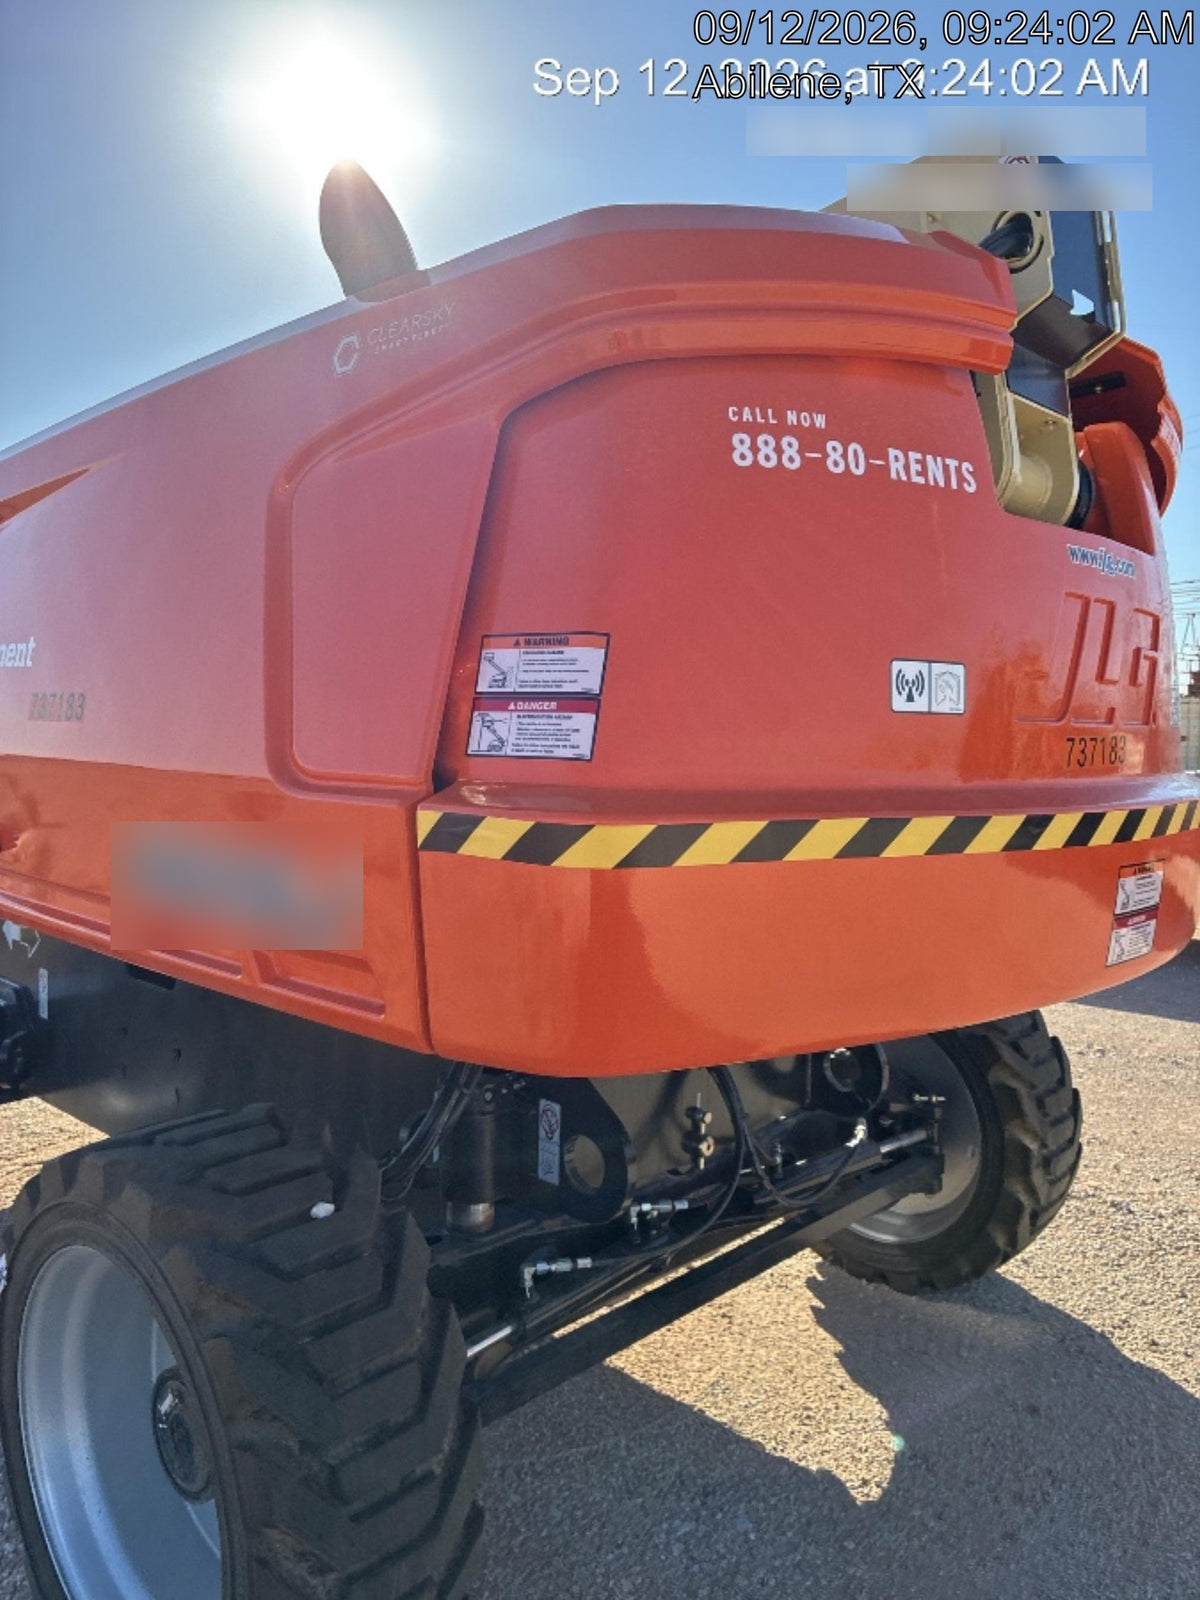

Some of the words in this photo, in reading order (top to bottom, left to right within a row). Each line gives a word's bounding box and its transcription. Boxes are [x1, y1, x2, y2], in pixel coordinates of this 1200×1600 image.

[728, 406, 778, 424] CALL
[787, 410, 827, 429] NOW
[732, 432, 977, 494] 888-80-RENTS
[523, 636, 570, 647] WARNING
[1016, 591, 1161, 727] JLG
[516, 701, 558, 711] DANGER
[1066, 734, 1127, 768] 737183
